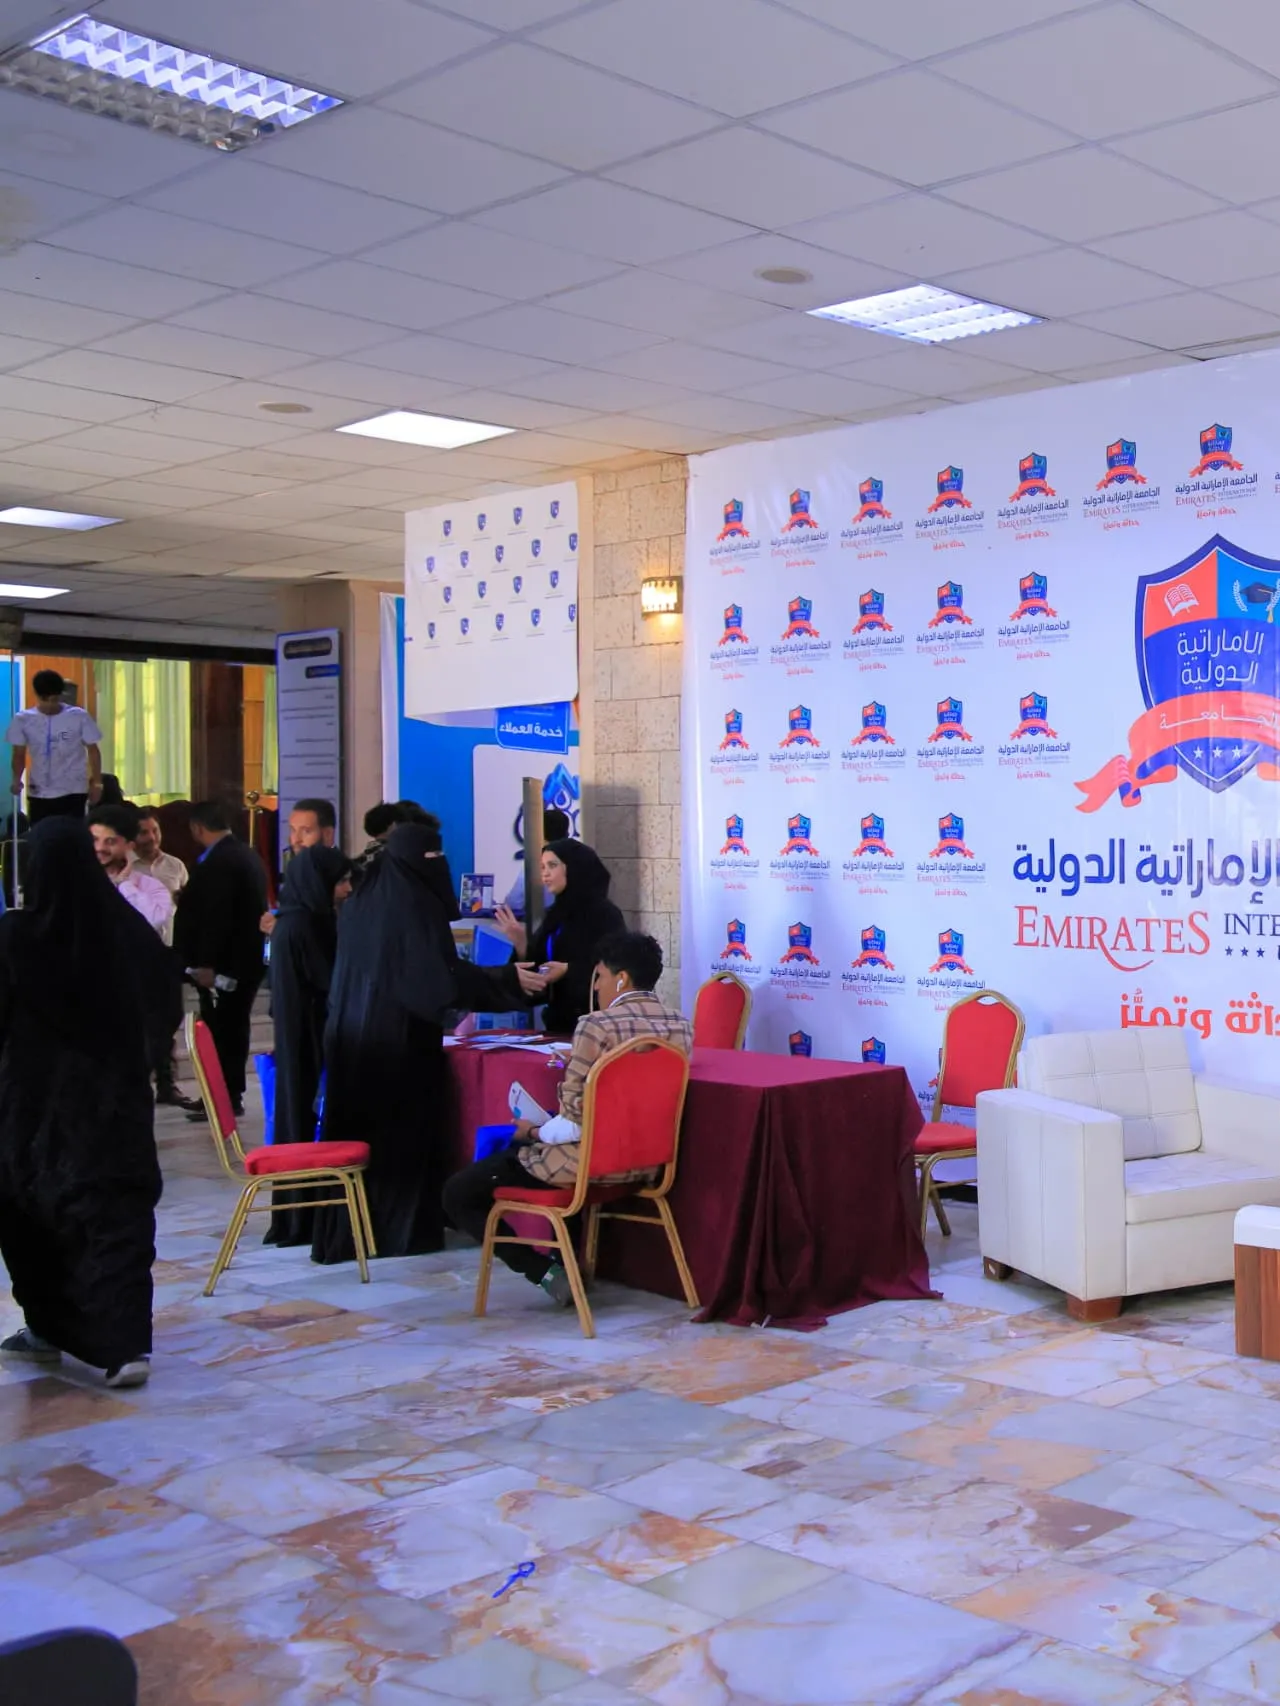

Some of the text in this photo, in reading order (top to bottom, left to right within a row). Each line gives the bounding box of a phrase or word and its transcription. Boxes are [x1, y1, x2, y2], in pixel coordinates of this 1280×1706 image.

[1181, 659, 1259, 690] الدولية
[499, 722, 563, 737] خدمة العملاء
[1013, 838, 1125, 896] الدولية
[1013, 905, 1211, 972] EMIRATES
